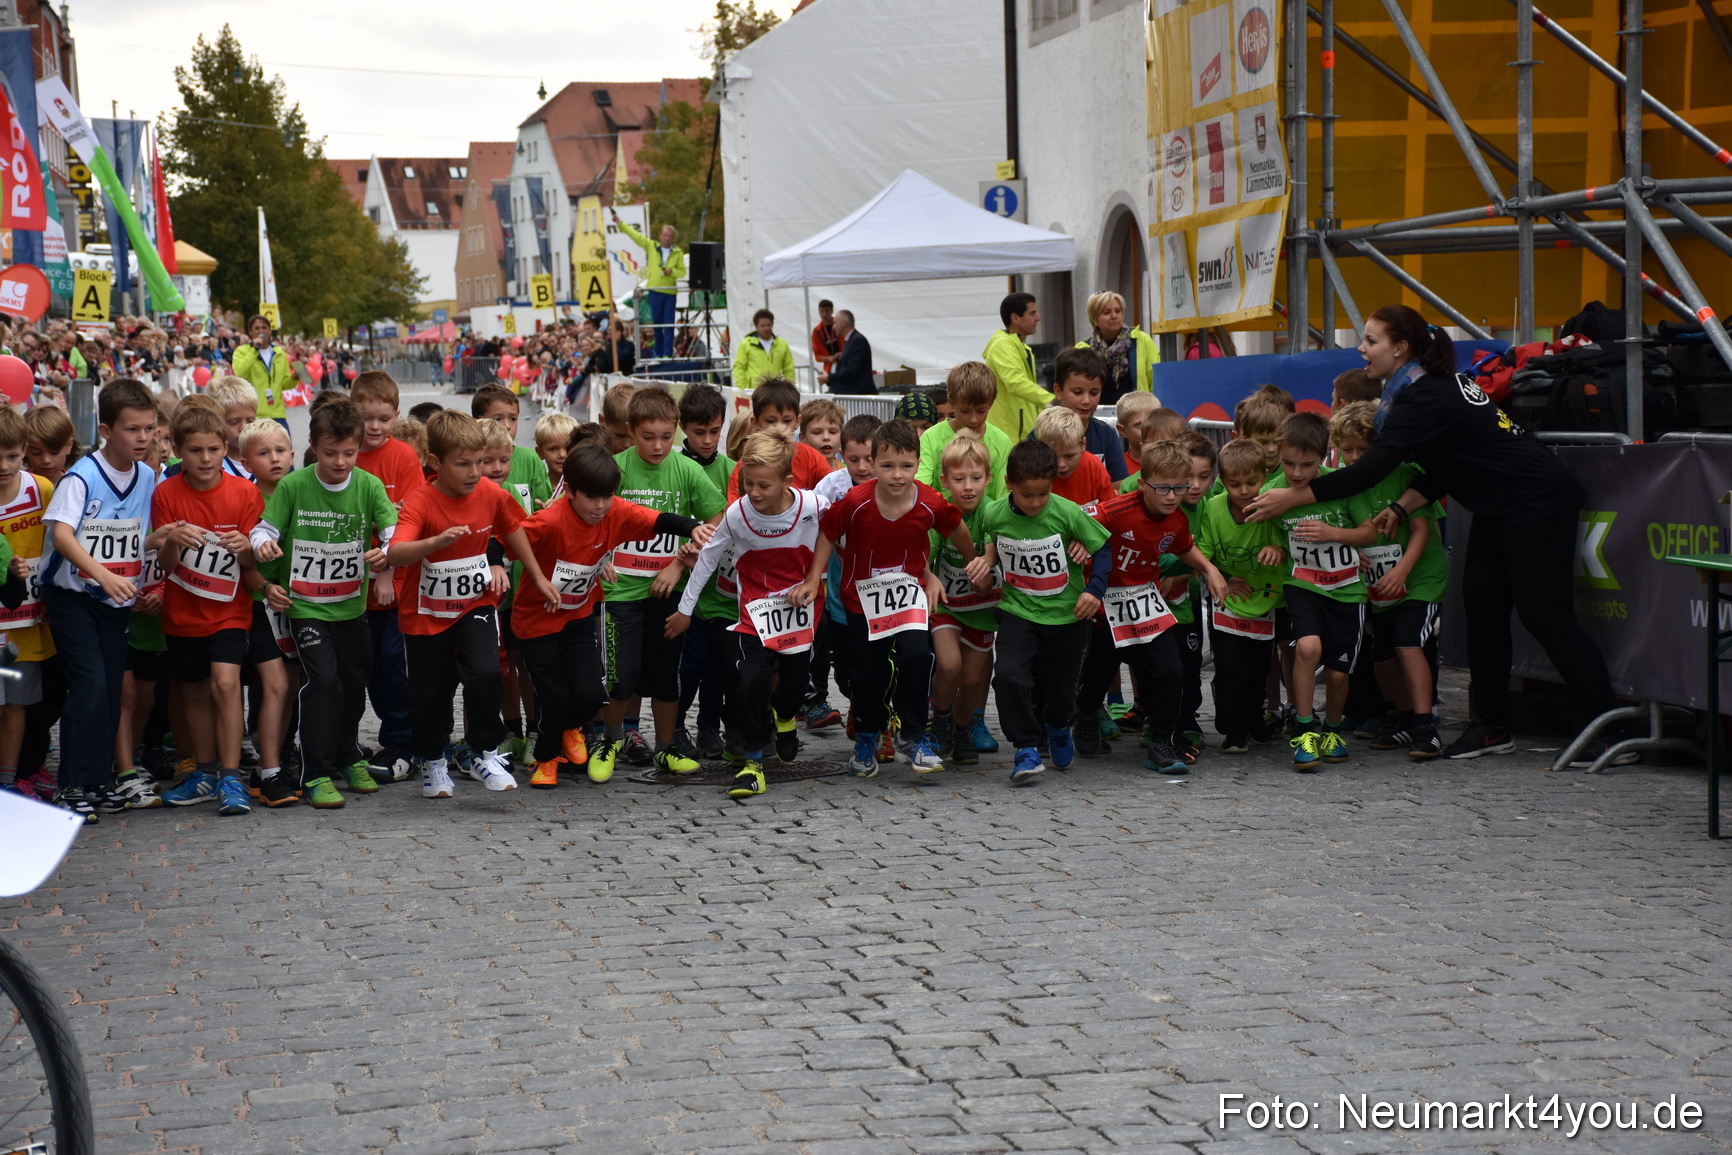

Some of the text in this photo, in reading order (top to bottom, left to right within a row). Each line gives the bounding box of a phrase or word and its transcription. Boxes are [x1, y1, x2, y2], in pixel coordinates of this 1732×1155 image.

[1241, 24, 1268, 56] Hervis
[1250, 158, 1276, 173] Neumarkter
[1246, 172, 1282, 193] Lammsbräu
[581, 263, 607, 272] Block
[1199, 259, 1221, 283] swn
[79, 271, 108, 282] Block
[537, 285, 549, 302] B
[587, 276, 605, 299] A
[81, 285, 102, 310] A
[297, 509, 346, 519] Neumarkter
[1286, 513, 1323, 525] umarkter
[297, 519, 337, 529] Stadtlauf
[86, 534, 140, 559] 7019
[294, 545, 318, 554] PARTL
[998, 541, 1051, 553] PARTL Neumarkt
[632, 558, 660, 568] Julian
[1004, 552, 1061, 575] 7436
[1296, 544, 1353, 569] 7110
[300, 556, 359, 580] 7125
[422, 564, 478, 574] PARTL Neumarkt
[556, 566, 579, 577] PARTL
[188, 573, 210, 589] Leon
[425, 572, 486, 597] 7188
[1313, 572, 1340, 583] Lukas
[317, 586, 337, 595] Luis
[858, 581, 881, 592] PARTL
[867, 583, 919, 615] 7427
[1104, 591, 1125, 600] PARTL
[446, 602, 465, 610] Erik
[750, 601, 772, 613] PARTL
[1111, 592, 1165, 623] 7073
[759, 606, 809, 634] 7076
[1132, 622, 1160, 636] Simon
[777, 636, 797, 648] Simon
[606, 621, 618, 683] predator
